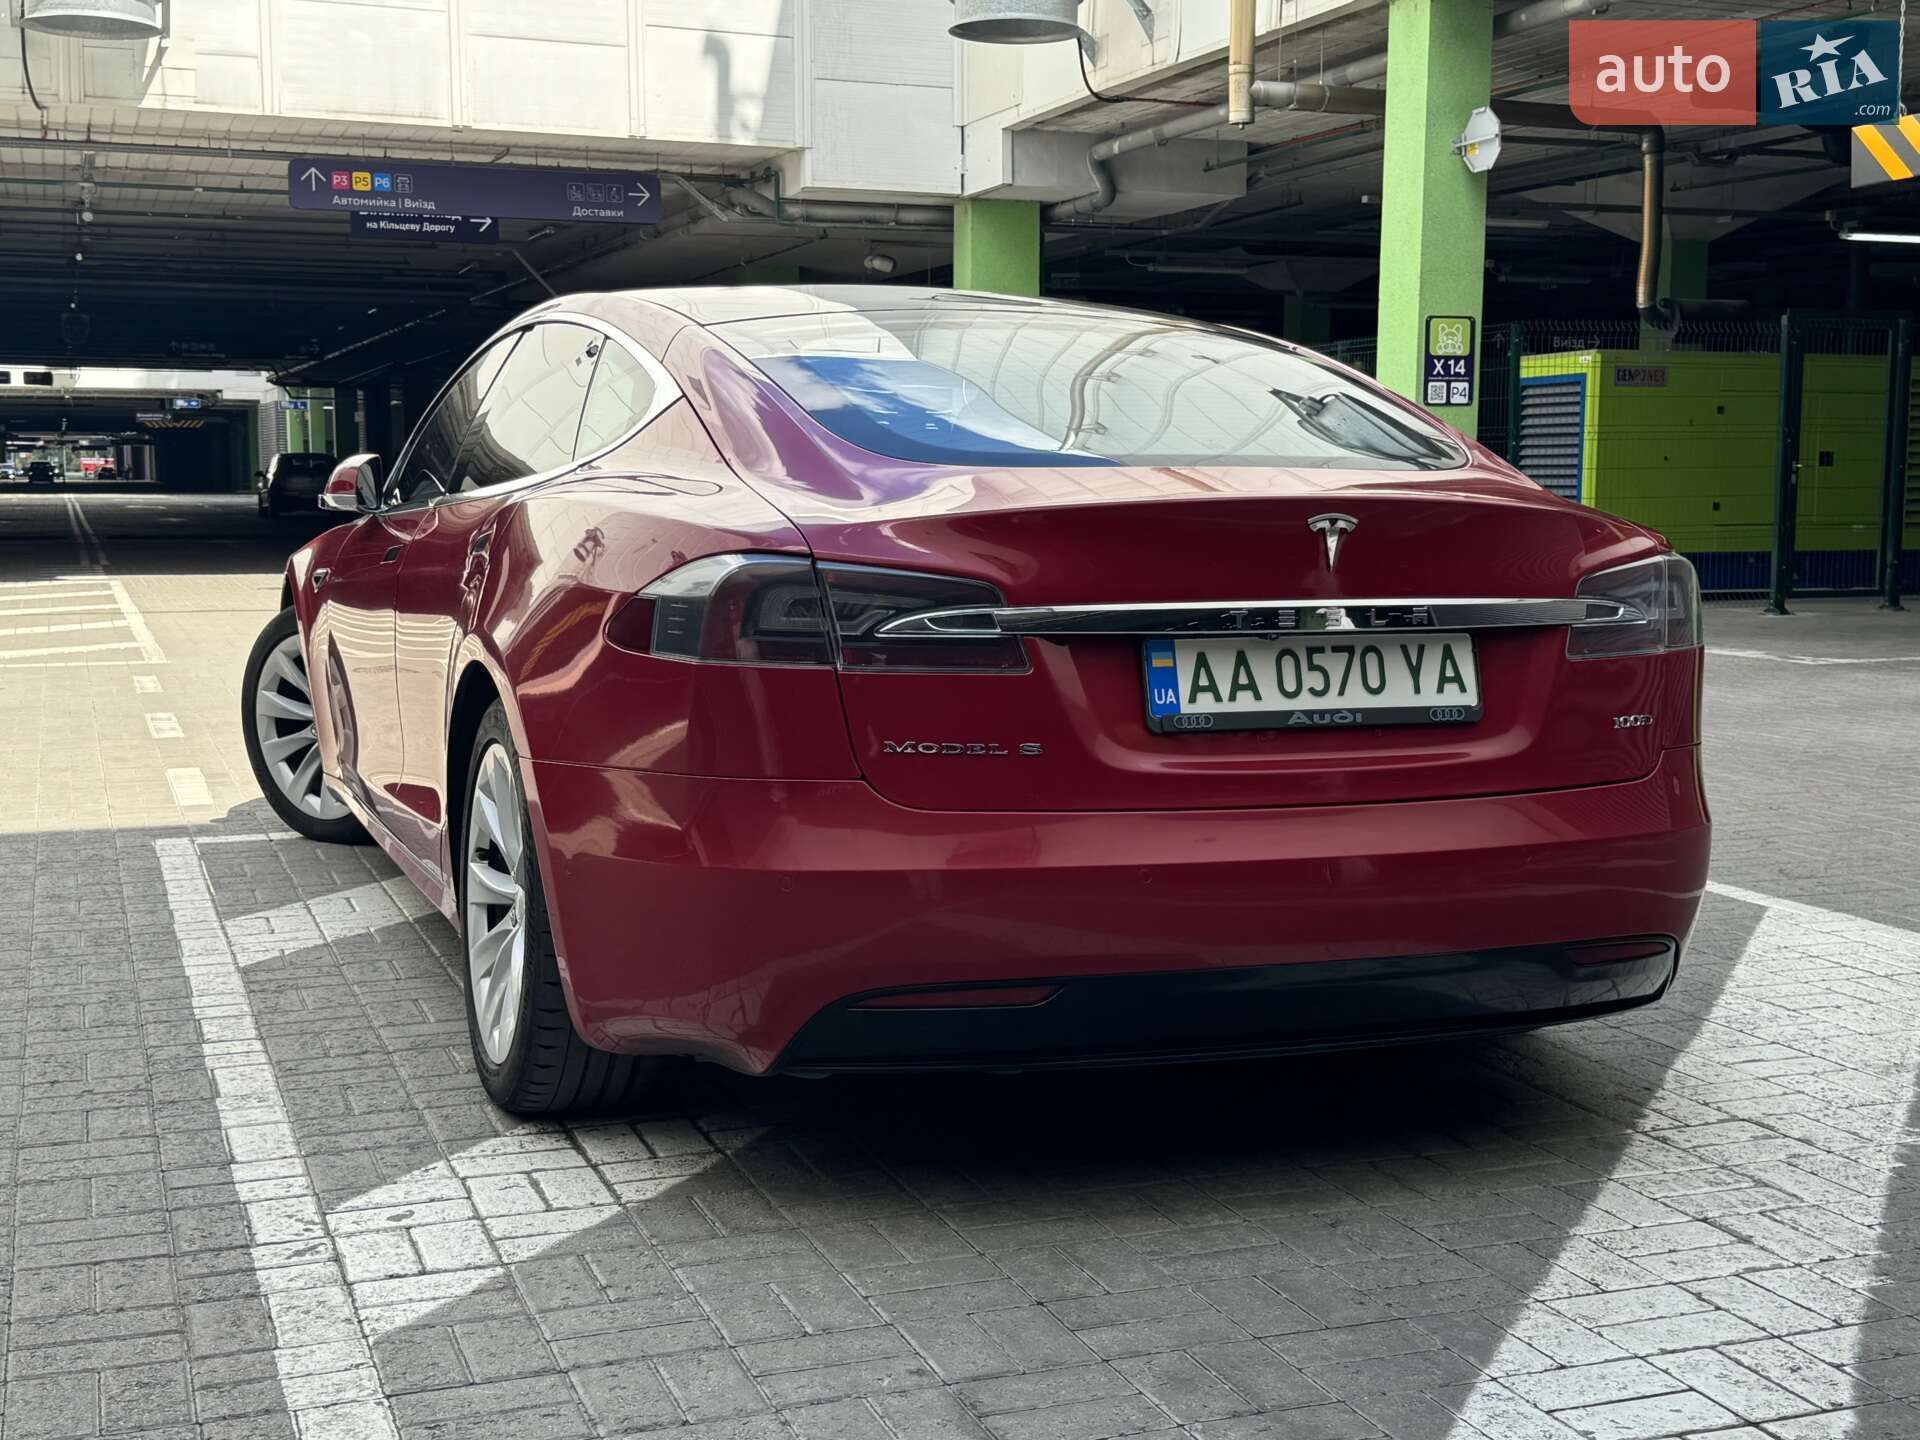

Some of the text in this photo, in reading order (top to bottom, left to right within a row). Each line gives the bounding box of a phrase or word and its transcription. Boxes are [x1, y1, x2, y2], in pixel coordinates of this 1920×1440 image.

[332, 175, 391, 188] P3 P5 P6
[332, 195, 397, 208] Автомийка
[404, 198, 436, 210] Виїзд
[572, 206, 624, 217] Доставки
[366, 221, 456, 234] на Кільцеву Дорогу
[1447, 359, 1466, 375] 14
[1451, 386, 1467, 399] P4
[1188, 650, 1263, 704] AA
[1275, 645, 1386, 699] 0570
[1155, 688, 1177, 705] UA
[1287, 710, 1363, 726] Audi
[883, 741, 1043, 755] MODEL S
